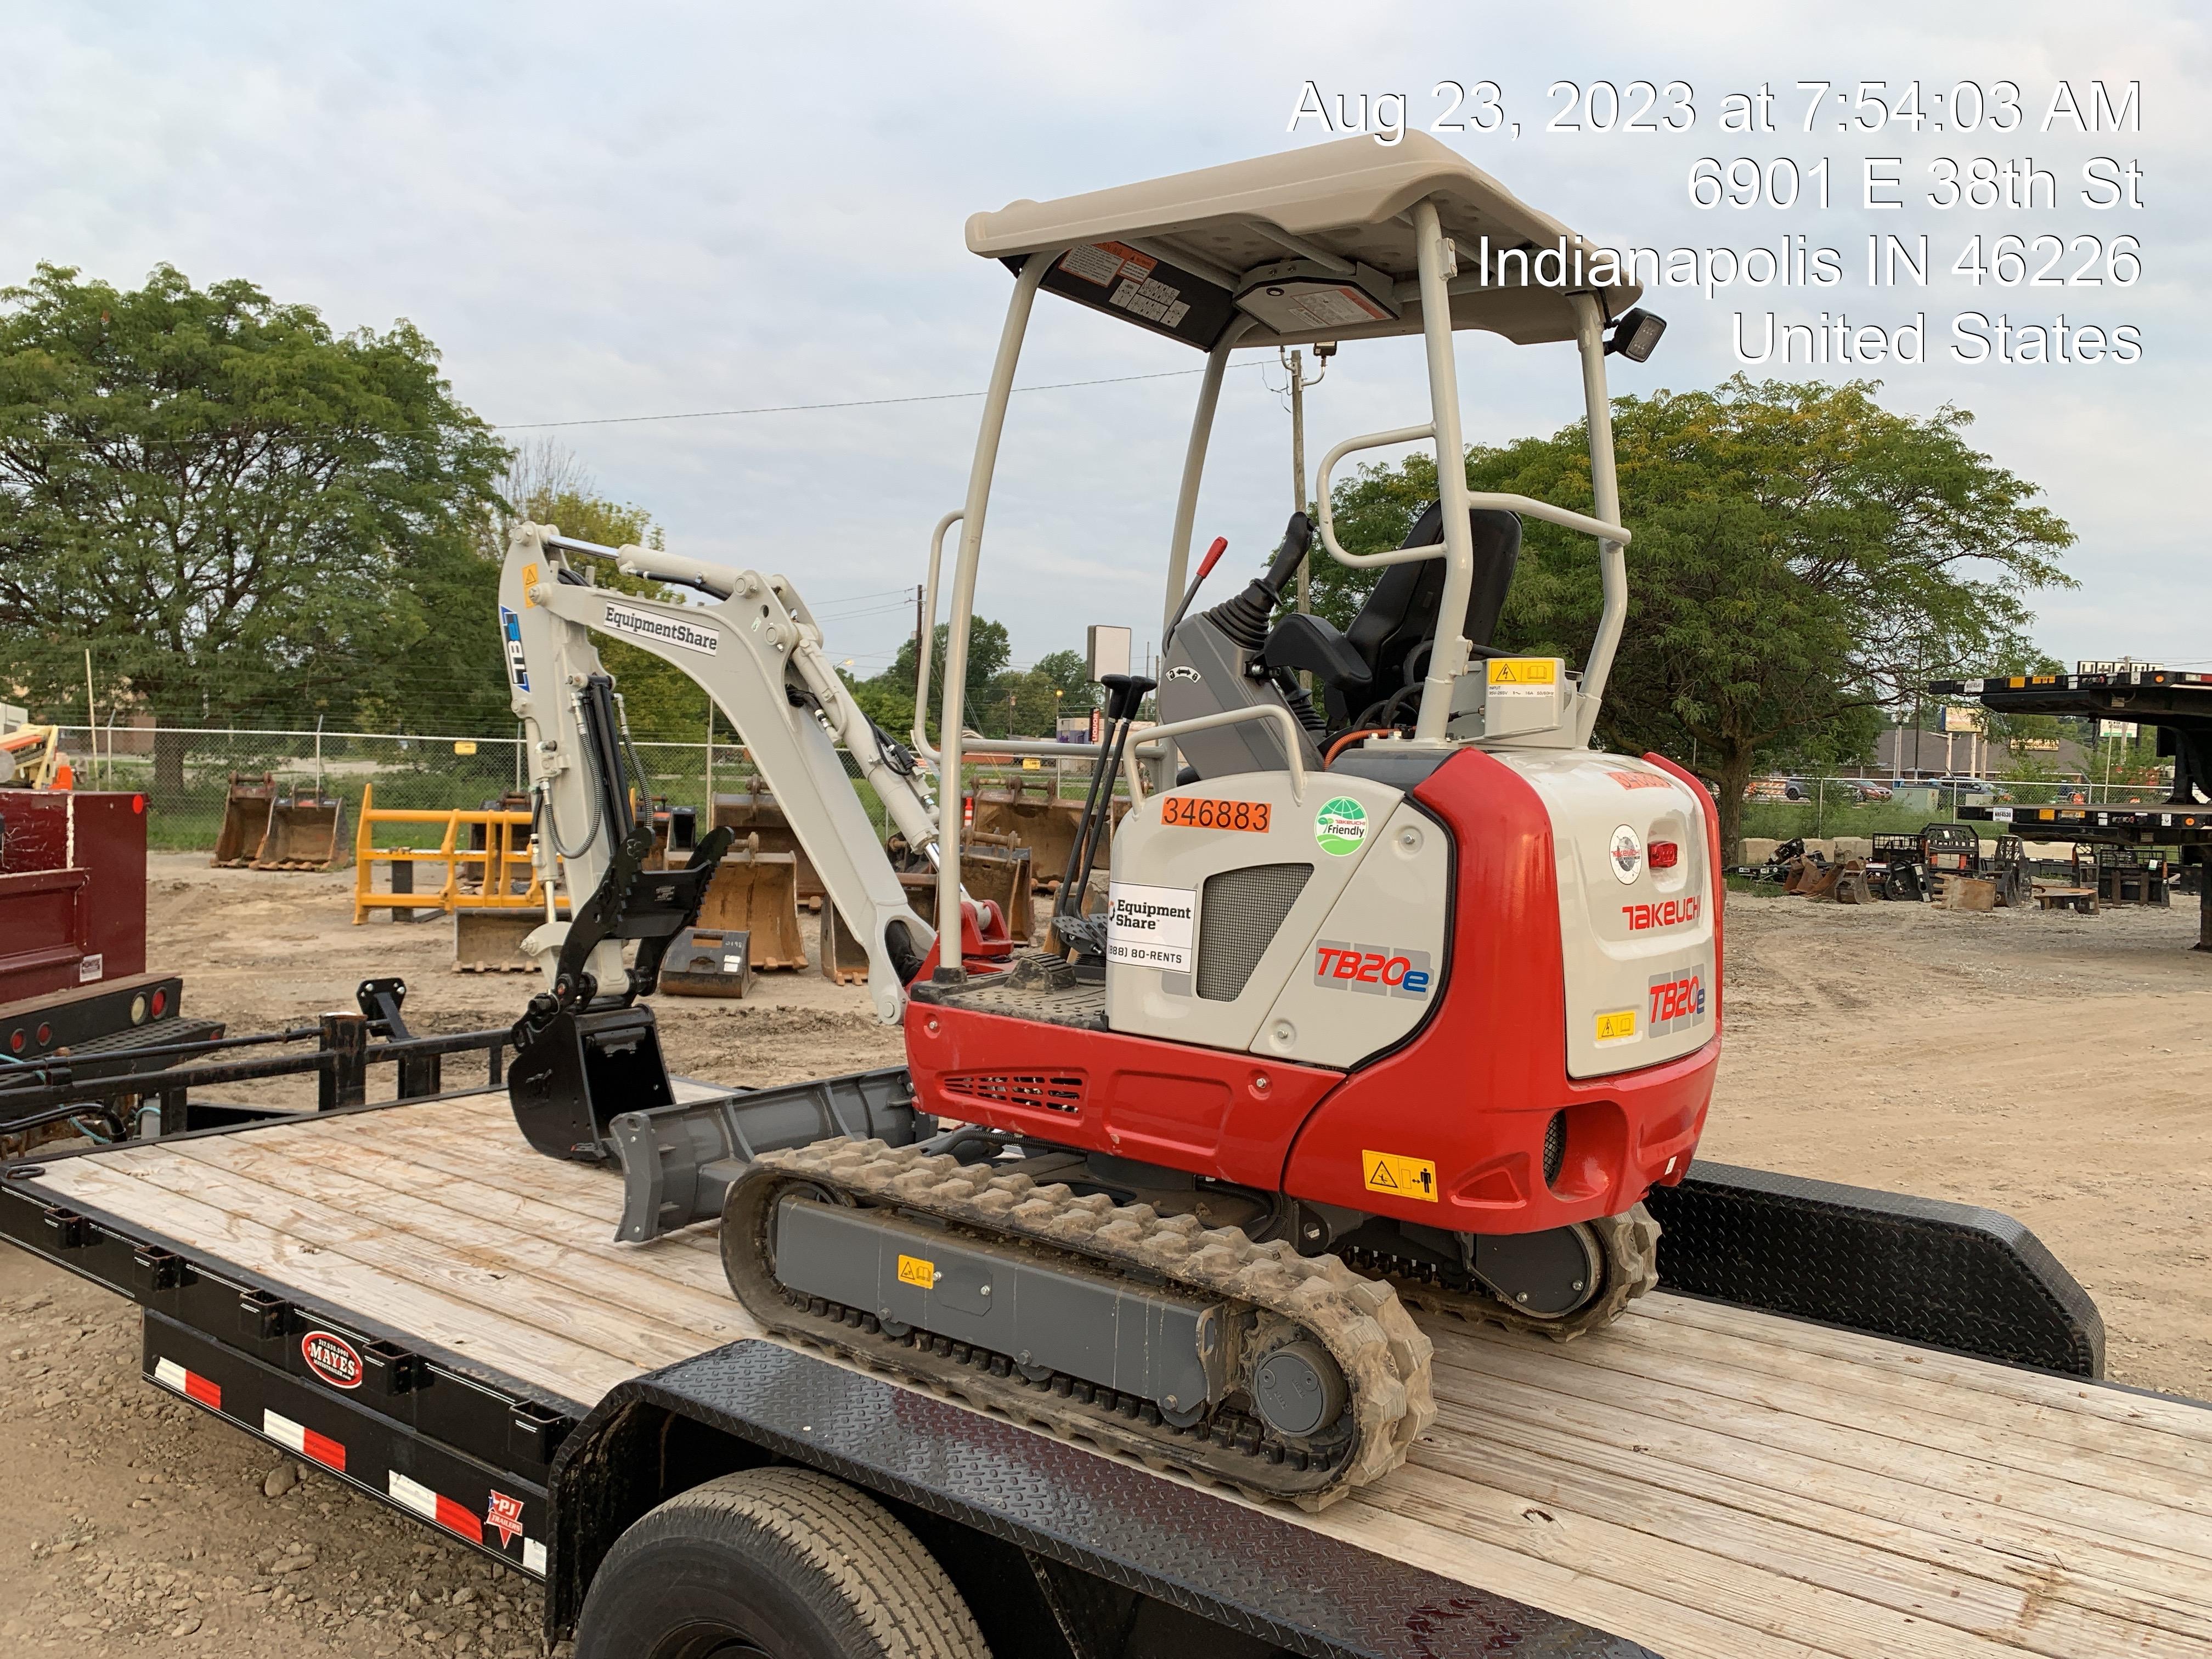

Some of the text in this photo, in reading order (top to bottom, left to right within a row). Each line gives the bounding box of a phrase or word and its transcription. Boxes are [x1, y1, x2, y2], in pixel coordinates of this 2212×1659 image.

[605, 606, 717, 650] EquipmentShare
[1164, 797, 1268, 831] 346883
[1116, 913, 1156, 930] Share
[1117, 899, 1191, 919] Equipment
[1108, 944, 1182, 963] (888) 80-RENTS
[1318, 947, 1429, 992] TB20e
[1650, 975, 1705, 1023] TB20e
[310, 1342, 355, 1376] MAYES
[498, 1498, 516, 1516] PJ
[491, 1514, 521, 1532] TRAILERS
